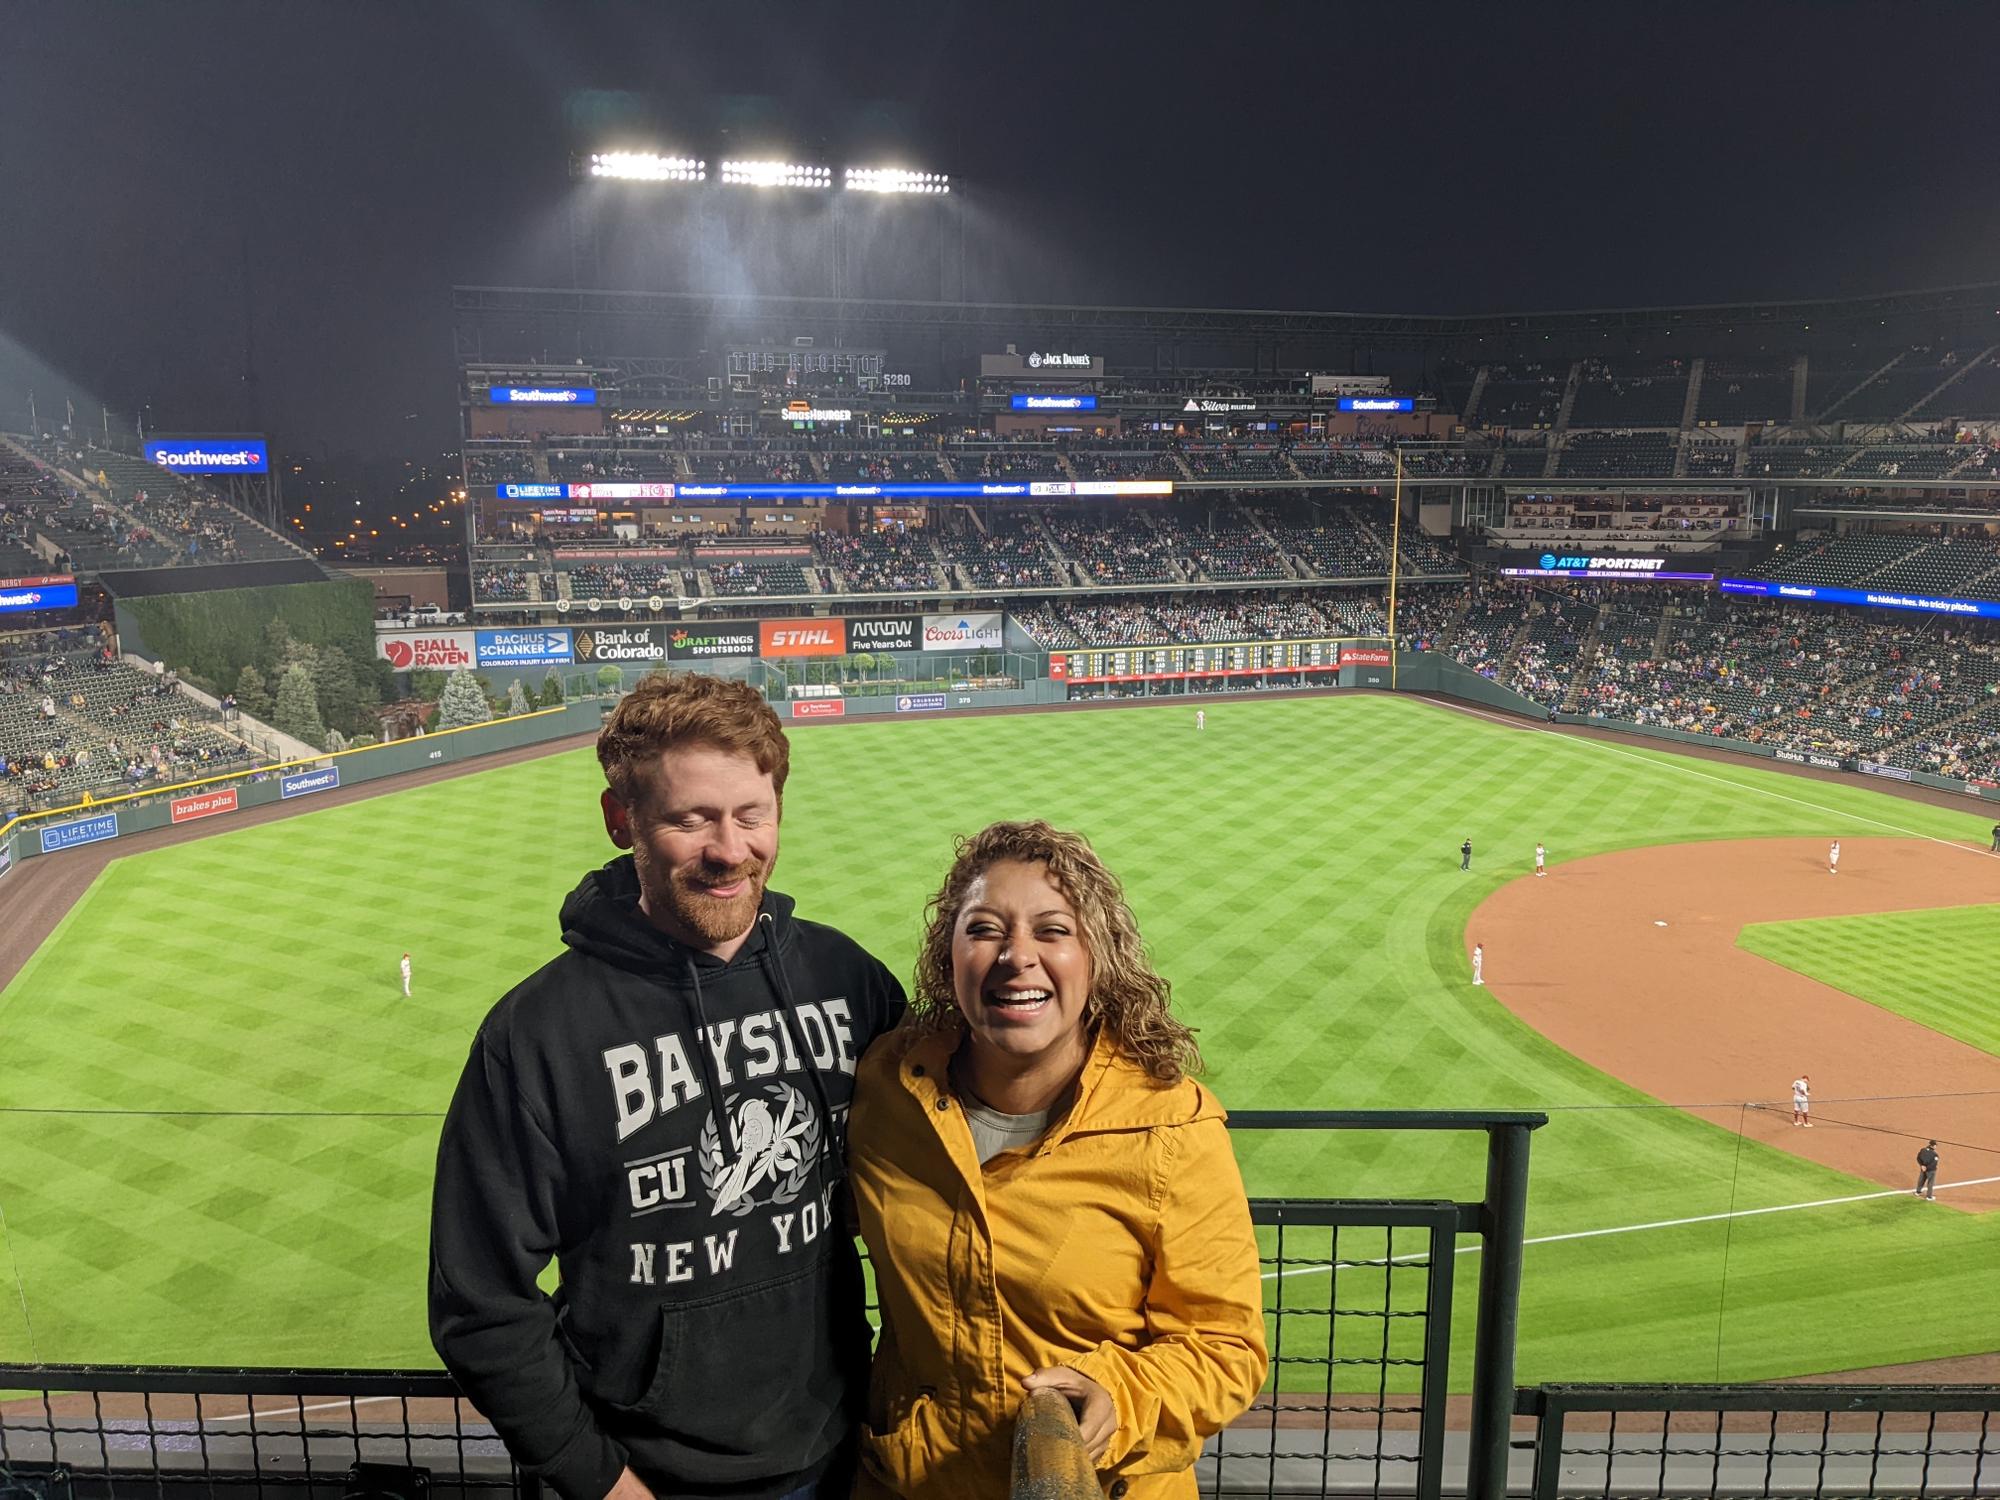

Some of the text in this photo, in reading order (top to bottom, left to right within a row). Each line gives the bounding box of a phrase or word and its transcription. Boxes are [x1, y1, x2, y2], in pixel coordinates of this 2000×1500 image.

[789, 352, 885, 373] ROOFTOP
[884, 374, 911, 386] 5280
[510, 389, 570, 401] Southwest
[1027, 397, 1077, 408] Southwest
[1201, 400, 1230, 411] Silver
[1352, 400, 1395, 410] Southwest
[155, 450, 248, 465] Southwest
[1557, 557, 1665, 569] AT&T SPORTSNET
[557, 601, 568, 611] 42
[621, 600, 630, 609] 17
[651, 600, 661, 608] 33
[1867, 594, 1979, 613] No hidden fees. No tricky pitches.
[495, 633, 545, 646] BACHUS
[595, 628, 650, 645] Bank of
[771, 630, 834, 647] STIHL
[925, 626, 1000, 641] Coors LIGHT
[674, 636, 754, 648] DRAFTKINGS
[853, 639, 912, 650] Five Years Out
[480, 644, 545, 657] SCHANKER
[595, 643, 664, 660] Colorado
[692, 645, 754, 655] SPORTSBOOK
[480, 659, 519, 667] COLORADO'S
[542, 658, 555, 666] LAW
[429, 750, 442, 759] 415
[1776, 750, 1839, 768] StubHub StubHub
[286, 775, 329, 792] Southwest
[176, 796, 233, 815] brakes plus
[61, 819, 113, 839] LIFETIME
[601, 996, 858, 1144] BAYSIDE
[628, 1157, 686, 1210] CU
[629, 1228, 739, 1286] NEW
